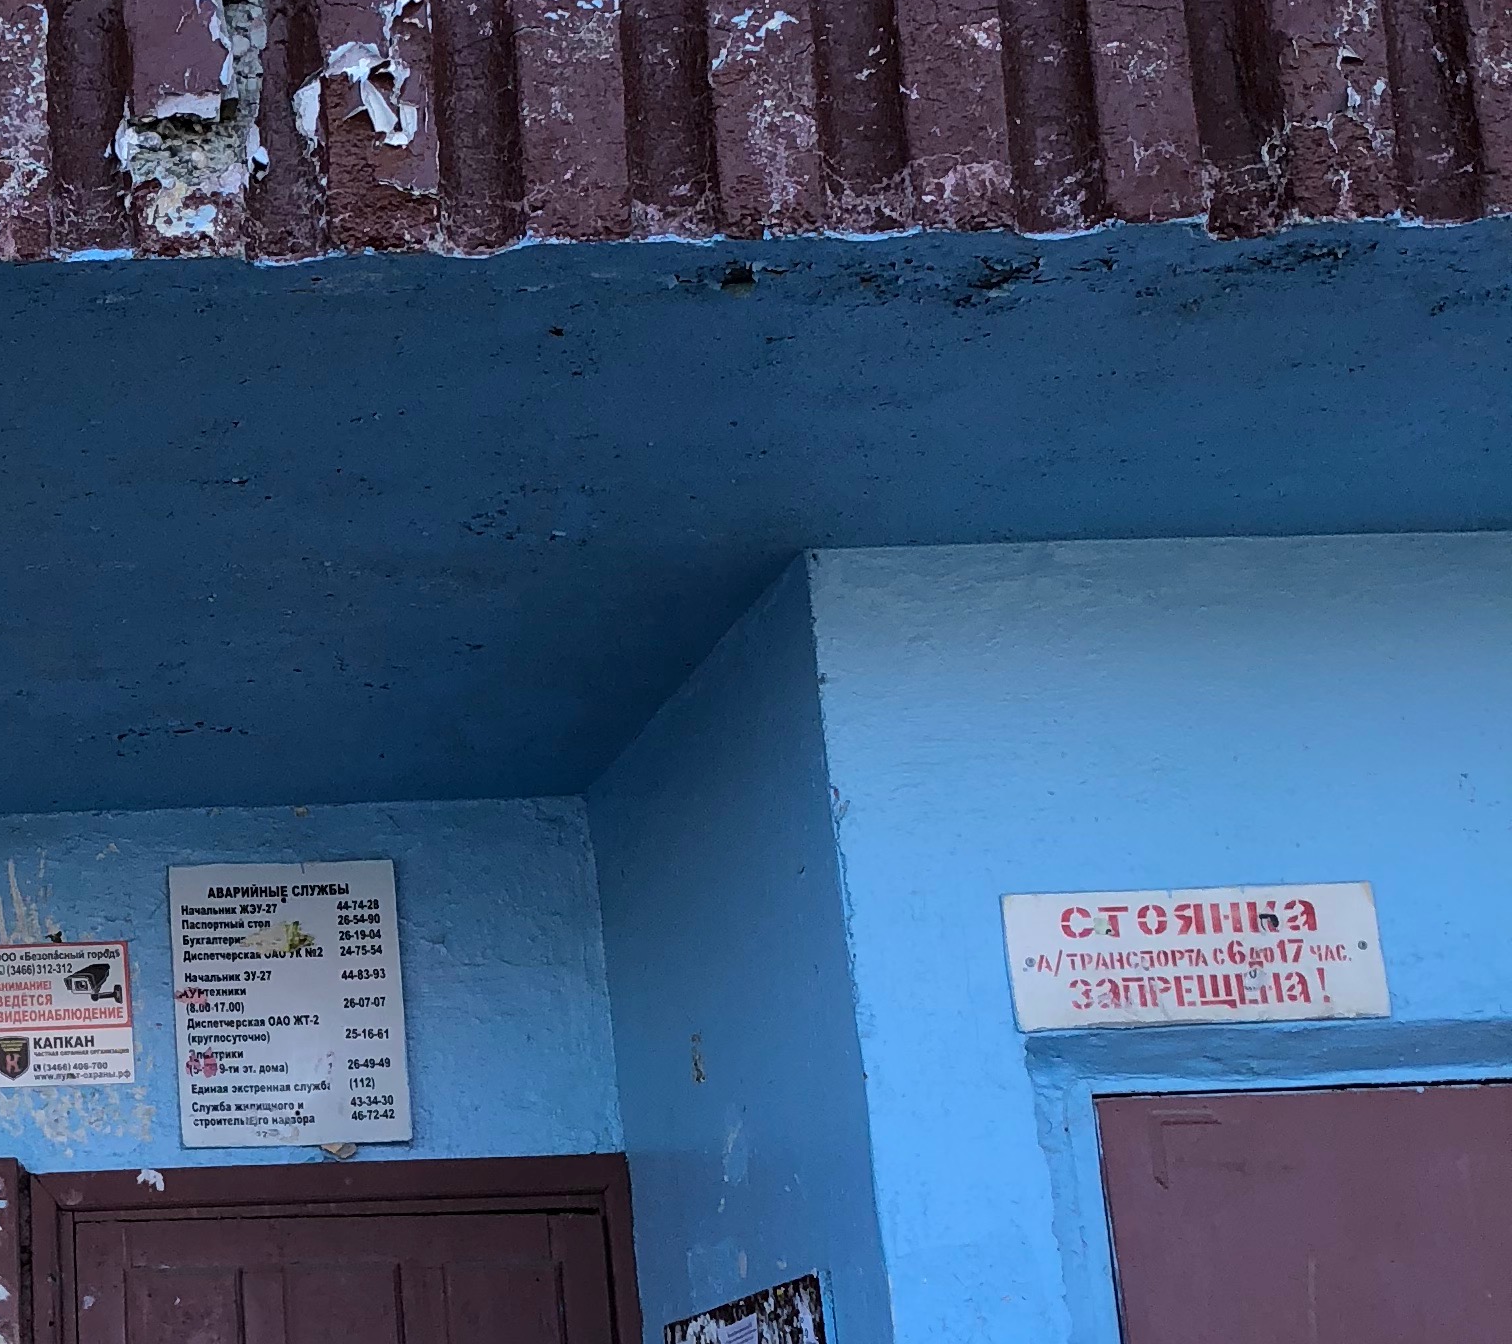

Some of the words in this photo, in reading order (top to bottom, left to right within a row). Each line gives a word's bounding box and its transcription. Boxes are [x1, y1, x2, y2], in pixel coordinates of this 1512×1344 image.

[207, 884, 288, 899] АВАРИЙНЫЕ
[291, 883, 350, 897] СЛУЖБЫ
[180, 905, 237, 916] Начальник
[239, 903, 278, 914] ЖЭУ-27
[336, 899, 380, 911] 44-74-28
[181, 918, 245, 932] Паспортный
[247, 920, 271, 929] стол
[337, 914, 381, 925] 26-54-90
[338, 929, 382, 941] 26-19-04
[304, 946, 324, 958] №2
[339, 945, 383, 957] 24-75-54
[1226, 940, 1246, 965] 6
[1276, 938, 1304, 963] 17
[184, 972, 241, 983] Начальник
[243, 971, 272, 981] ЭУ-27
[341, 968, 386, 980] 44-83-93
[343, 997, 386, 1009] 26-07-07
[186, 1017, 266, 1031] Диспетчерская
[267, 1015, 291, 1027] ОАО
[293, 1014, 320, 1026] ЖТ-2
[187, 1030, 271, 1046] (круглосуточно)
[345, 1028, 390, 1040] 25-16-61
[32, 1035, 96, 1050] КАПКАН
[258, 1062, 289, 1075] дома)
[347, 1057, 392, 1070] 26-49-49
[191, 1084, 229, 1096] Единая
[231, 1083, 291, 1095] экстренная
[349, 1077, 376, 1091] (112)
[350, 1095, 394, 1107] 43-34-30
[191, 1101, 232, 1115] Служба
[351, 1109, 396, 1121] 46-72-42
